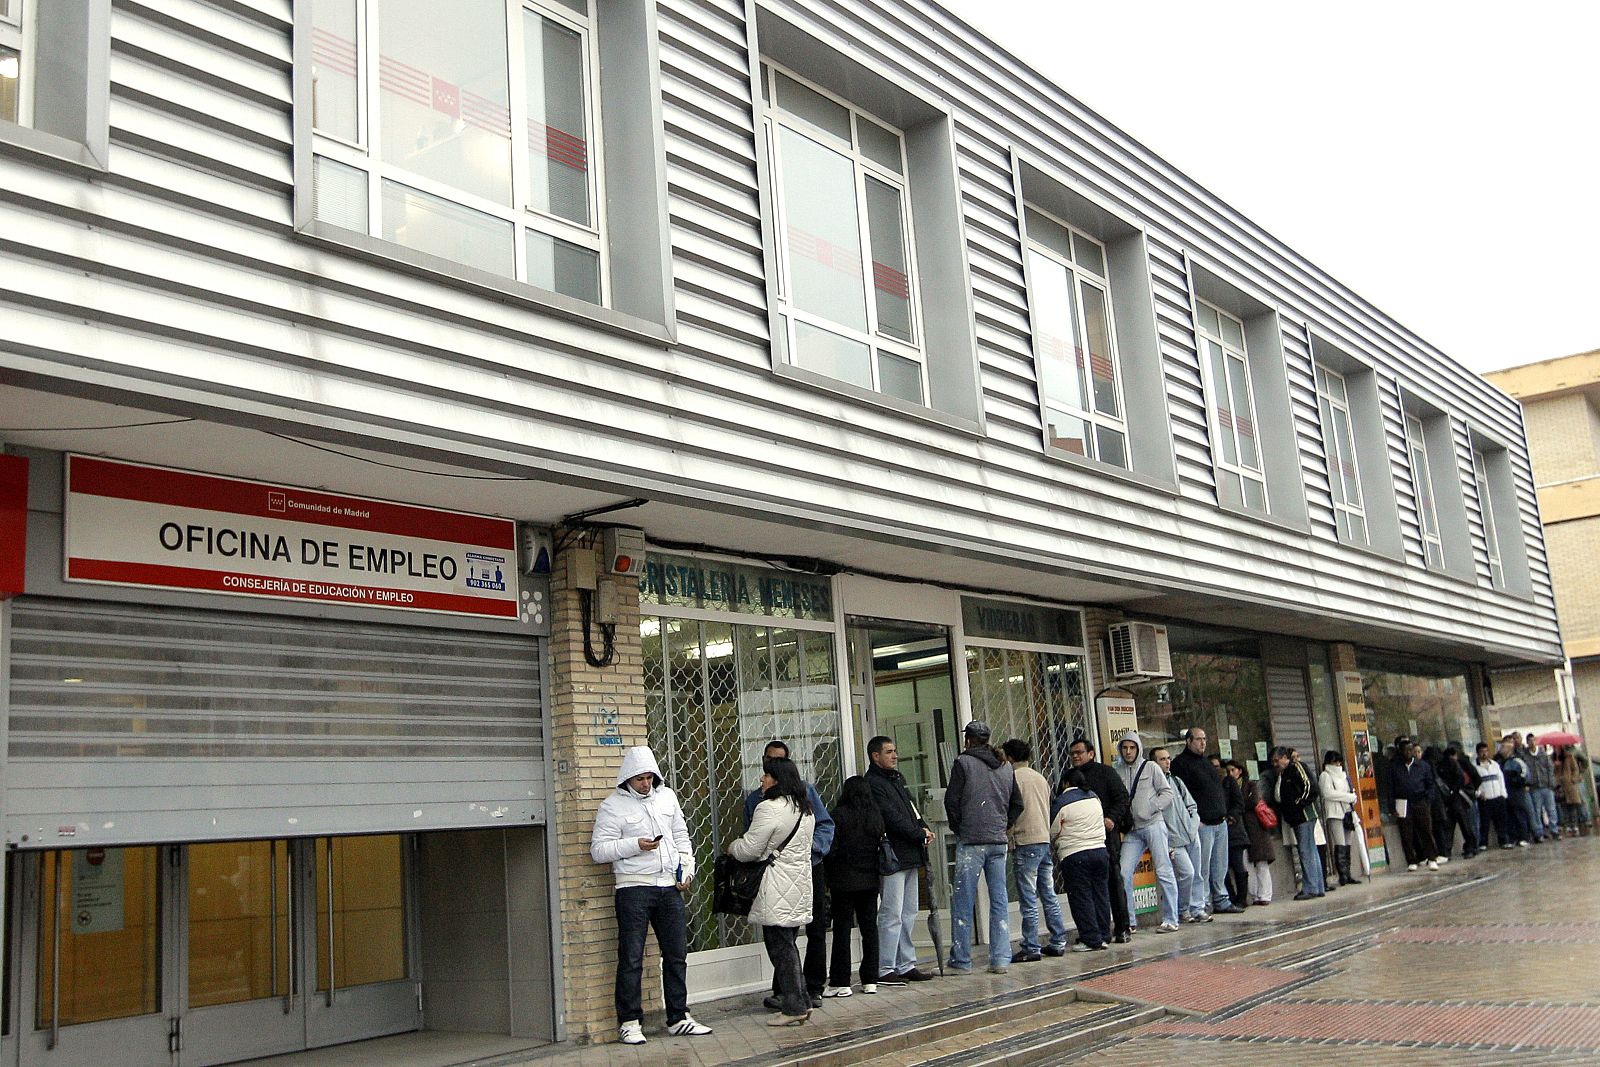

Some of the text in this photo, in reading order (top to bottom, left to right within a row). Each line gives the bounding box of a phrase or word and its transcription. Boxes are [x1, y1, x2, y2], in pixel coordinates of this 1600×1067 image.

[288, 500, 370, 519] Comunidad de Madrid
[159, 522, 457, 581] OFICINA DE EMPLEO
[223, 575, 414, 603] CONSEJERÍA DE EDUCACIÓN Y EMPLEO
[470, 579, 480, 587] 902
